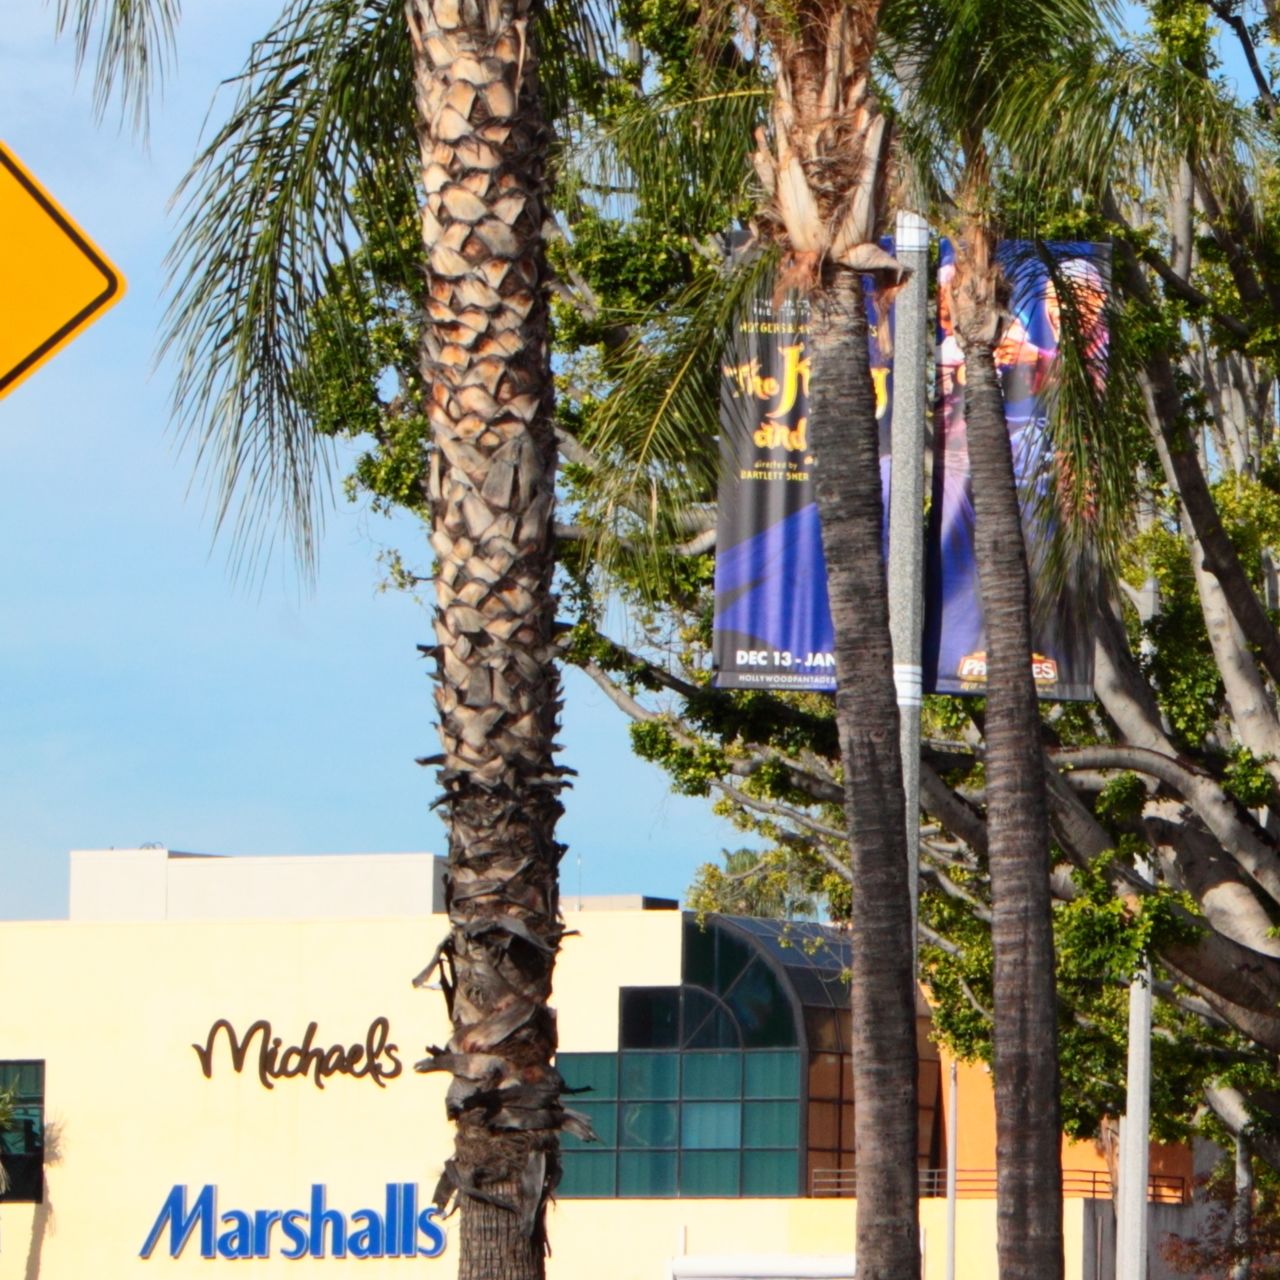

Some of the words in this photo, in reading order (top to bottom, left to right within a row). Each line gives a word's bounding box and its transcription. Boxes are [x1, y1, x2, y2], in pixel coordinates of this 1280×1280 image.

[753, 416, 807, 453] and
[736, 650, 767, 665] DEC
[773, 651, 791, 666] 13
[191, 1016, 402, 1090] Michaels
[138, 1183, 448, 1260] Marshalls
